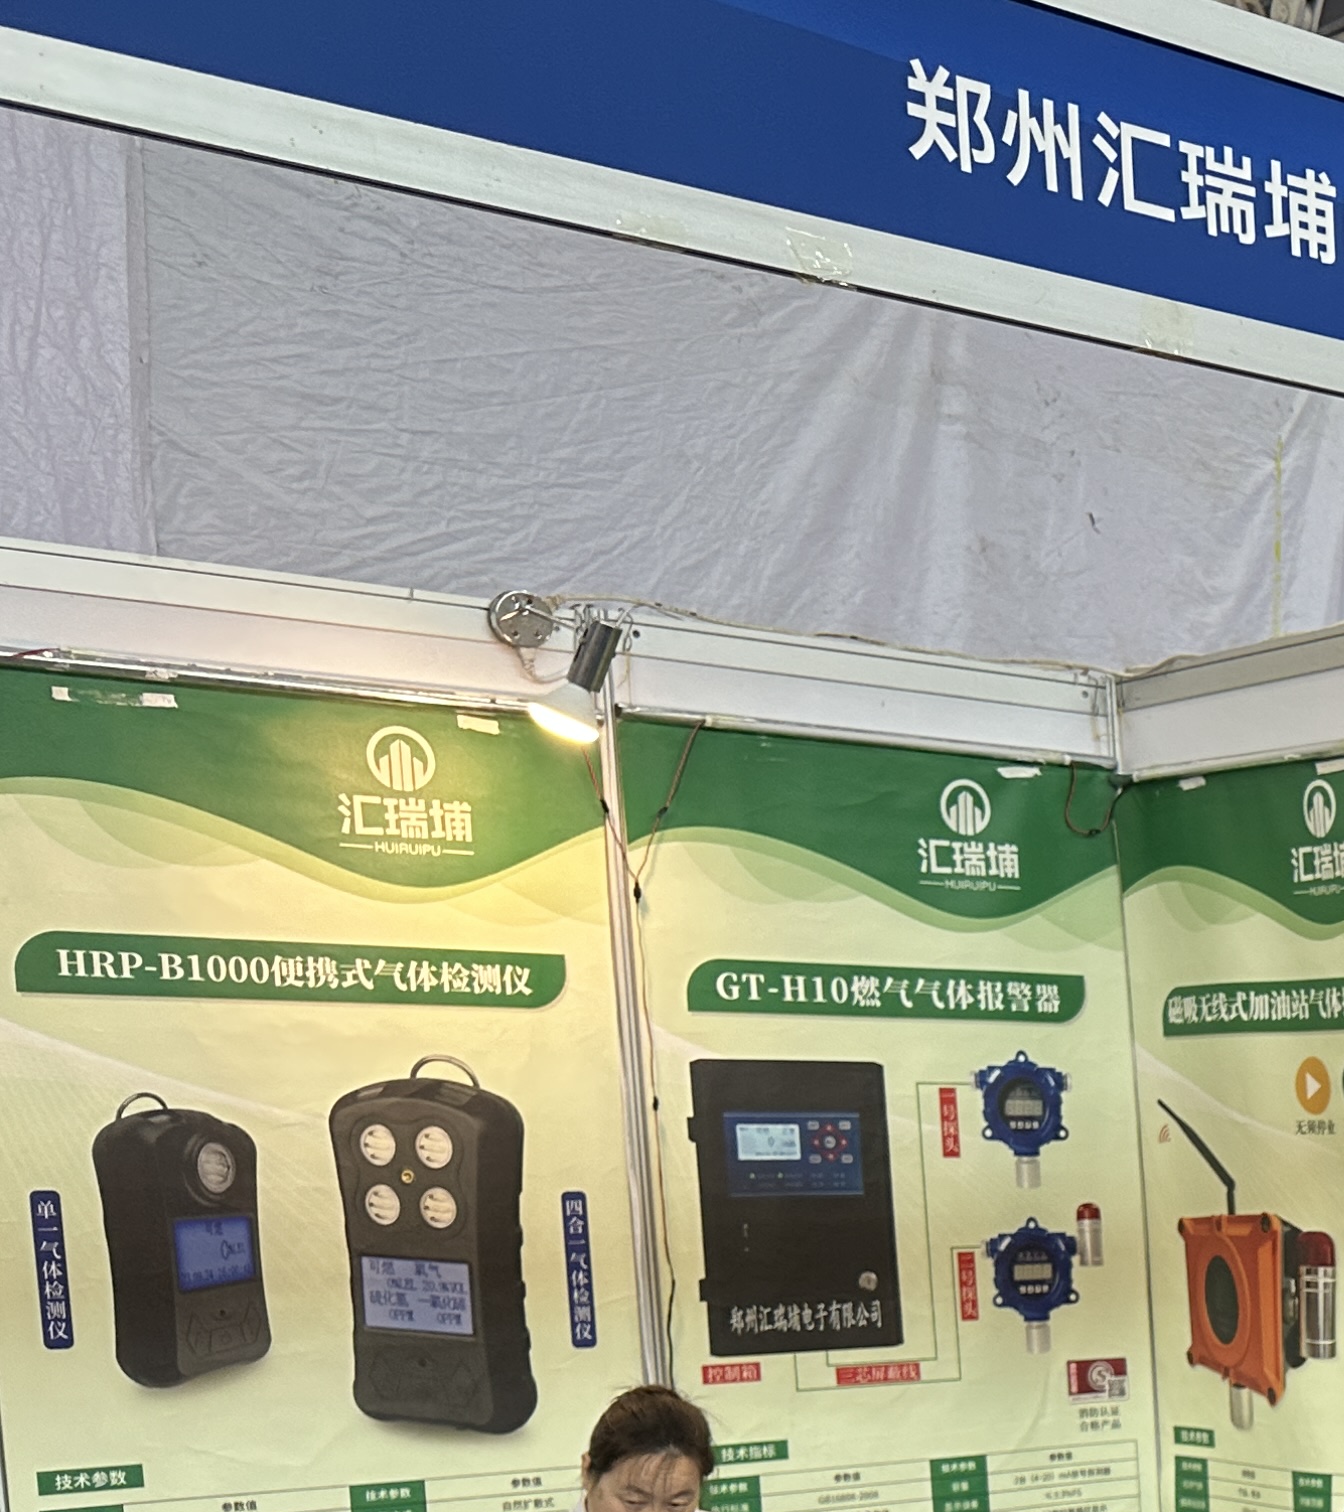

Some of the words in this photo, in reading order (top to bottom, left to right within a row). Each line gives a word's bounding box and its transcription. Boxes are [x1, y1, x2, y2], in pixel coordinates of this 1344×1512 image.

[338, 793, 473, 843] 汇瑞埔
[375, 841, 443, 857] HUIRUIPU
[917, 838, 1020, 880] 汇瑞埔
[55, 948, 533, 997] HRP-B1000便携式气体检测仪
[715, 971, 1061, 1014] GT-H10燃气气体报警器
[35, 1199, 71, 1342] 单一气体检测仪
[563, 1197, 594, 1342] 四合一气体检测仪
[721, 1445, 776, 1462] 技术指标
[55, 1470, 127, 1491] 技术参数
